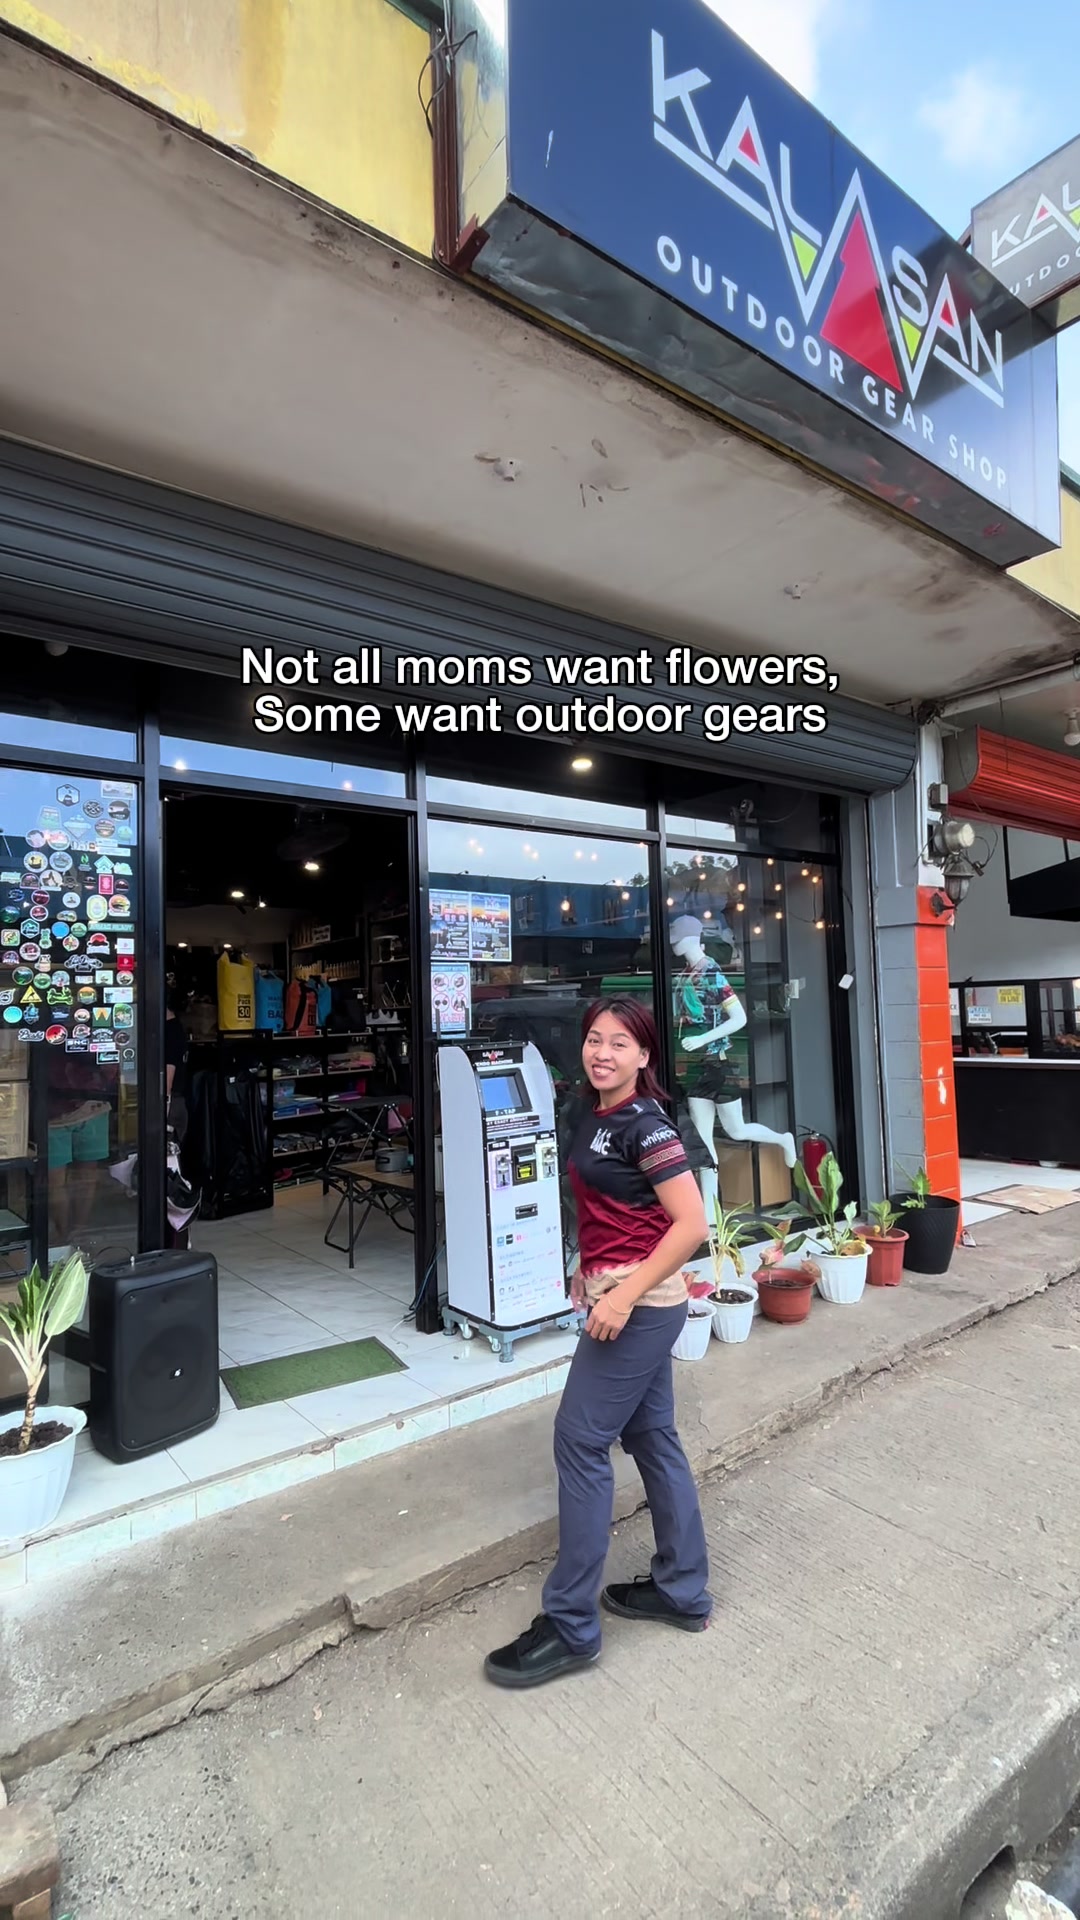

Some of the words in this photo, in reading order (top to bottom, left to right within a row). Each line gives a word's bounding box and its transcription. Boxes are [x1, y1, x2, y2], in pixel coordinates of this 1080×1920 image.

[657, 235, 846, 385] OUTDOOR
[862, 375, 935, 444] GEAR
[948, 435, 1007, 490] SHOP
[239, 1007, 250, 1018] 30
